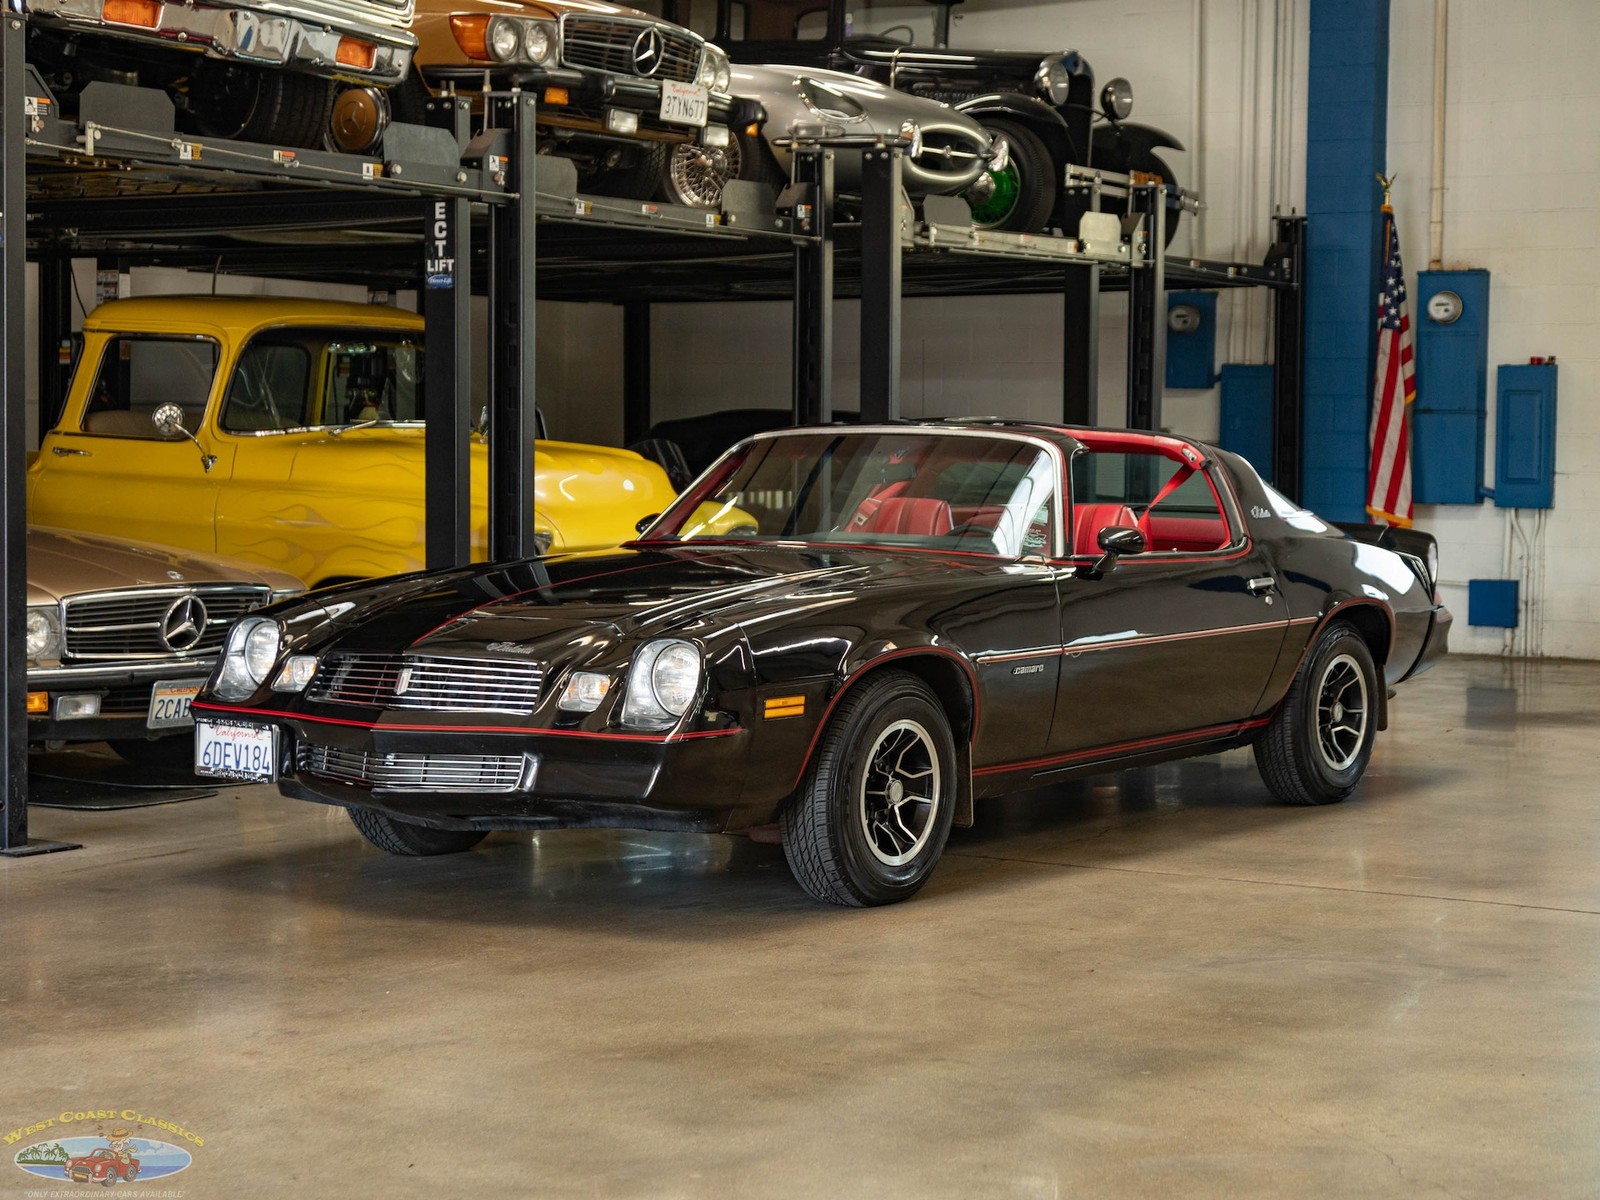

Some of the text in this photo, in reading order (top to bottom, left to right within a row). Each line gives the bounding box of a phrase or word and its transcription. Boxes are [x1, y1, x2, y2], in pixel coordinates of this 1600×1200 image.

[665, 95, 705, 119] 3TYN677
[427, 259, 455, 272] LIFT
[214, 724, 263, 741] California
[202, 740, 270, 773] 6DEV184
